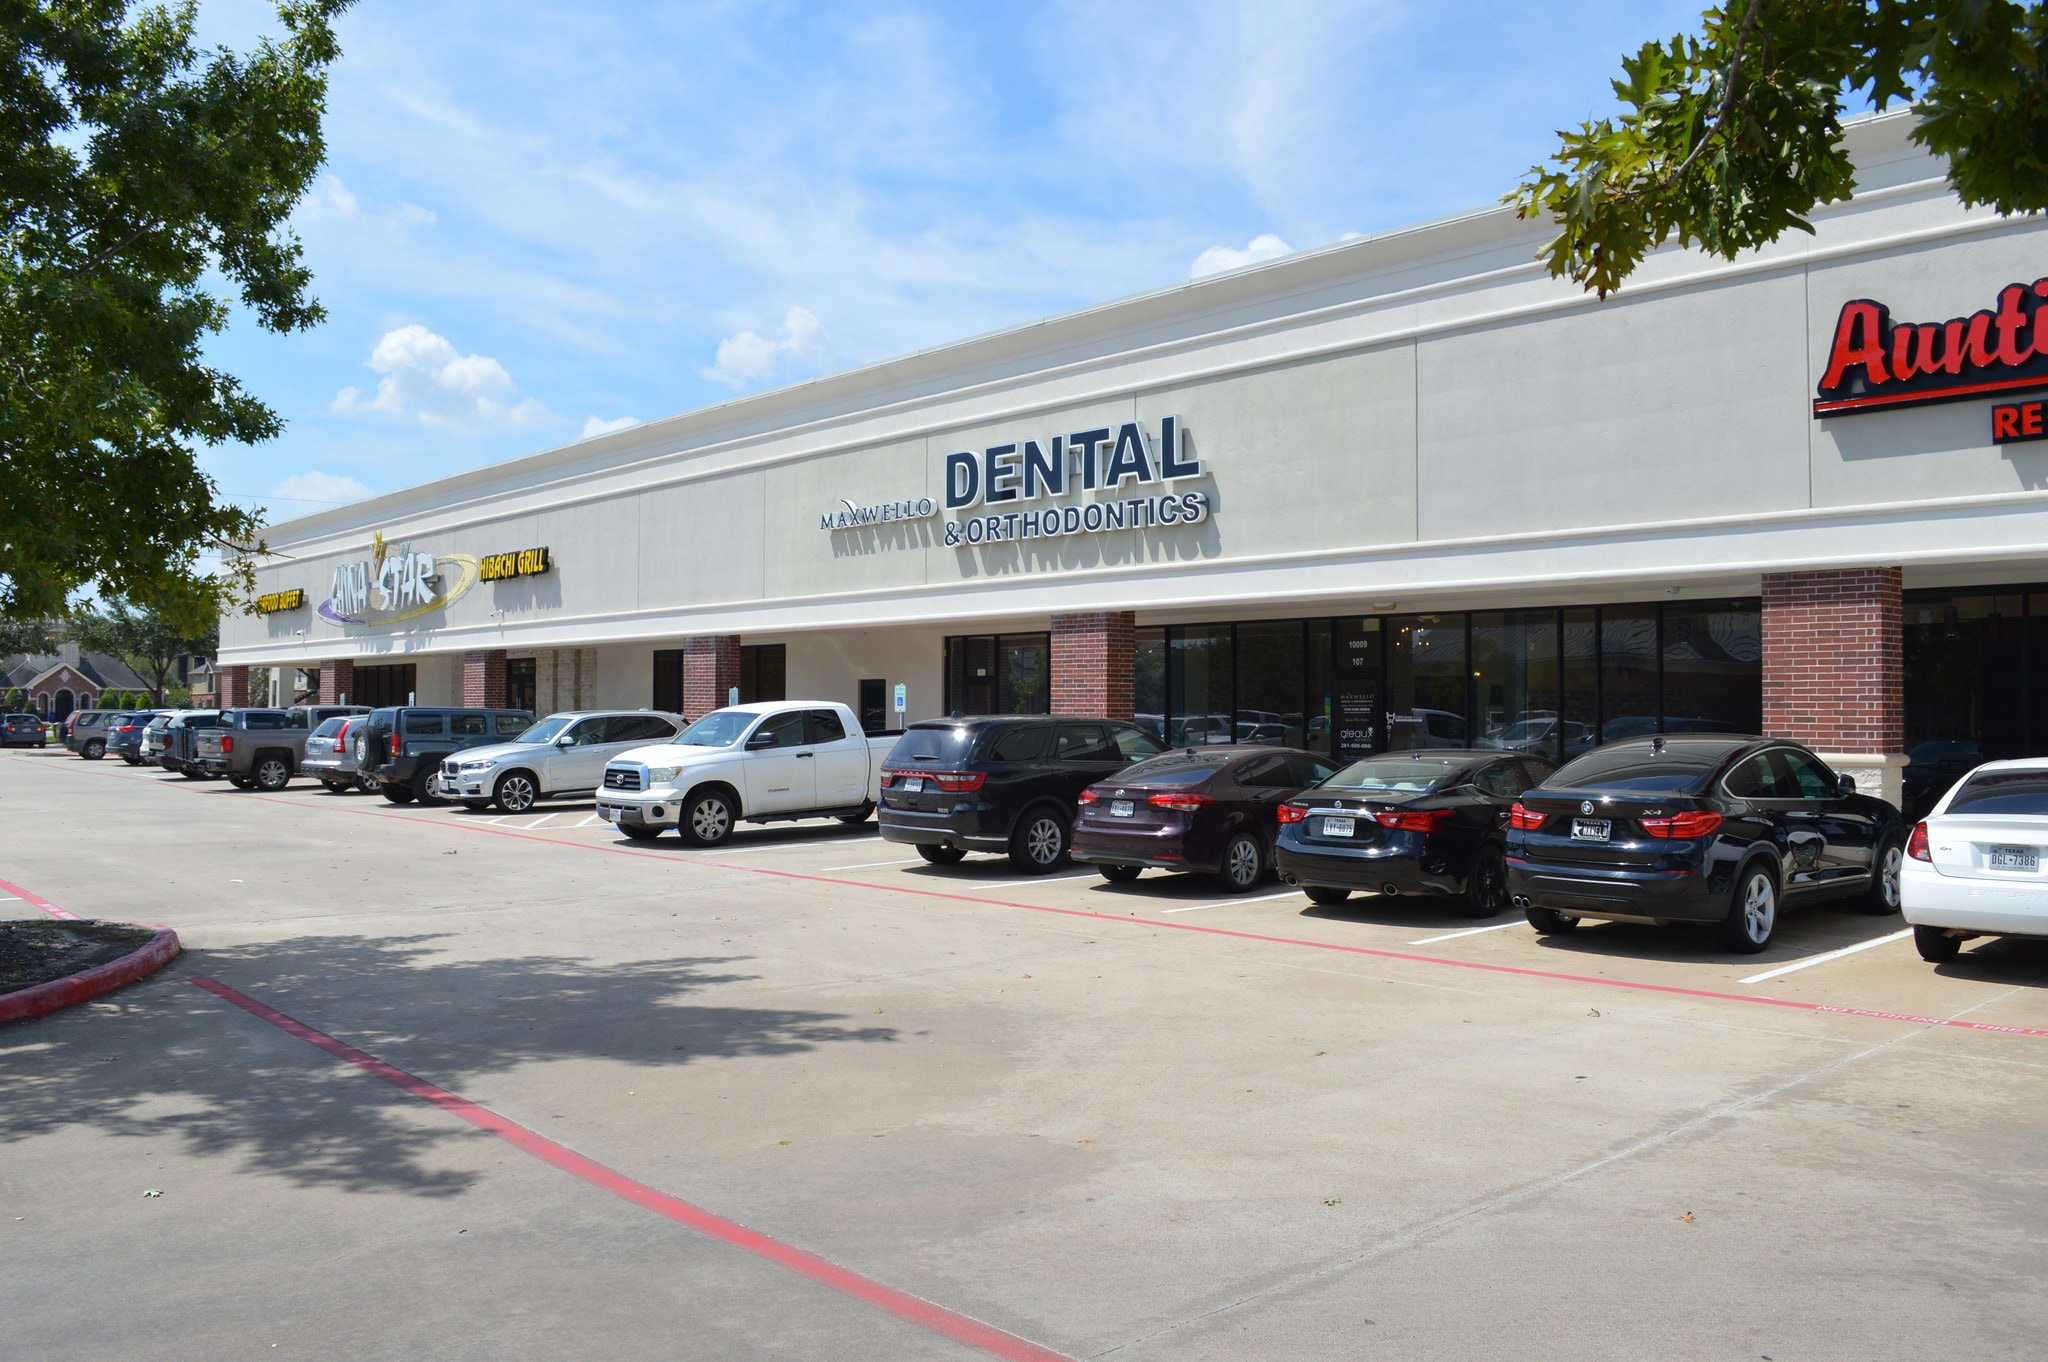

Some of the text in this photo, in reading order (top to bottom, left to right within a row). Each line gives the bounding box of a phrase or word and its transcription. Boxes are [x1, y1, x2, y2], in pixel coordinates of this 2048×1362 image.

[945, 414, 1205, 511] DENTAL
[820, 498, 937, 529] MAXWELLO
[944, 492, 1206, 548] & ORTHODONTICS
[480, 548, 545, 580] HIBACHI GRILL
[379, 552, 437, 611] STAR
[279, 589, 300, 609] BUFFET
[1352, 657, 1364, 666] 107
[1816, 1005, 1848, 1013] NO
[1851, 1009, 1950, 1025] PARKING
